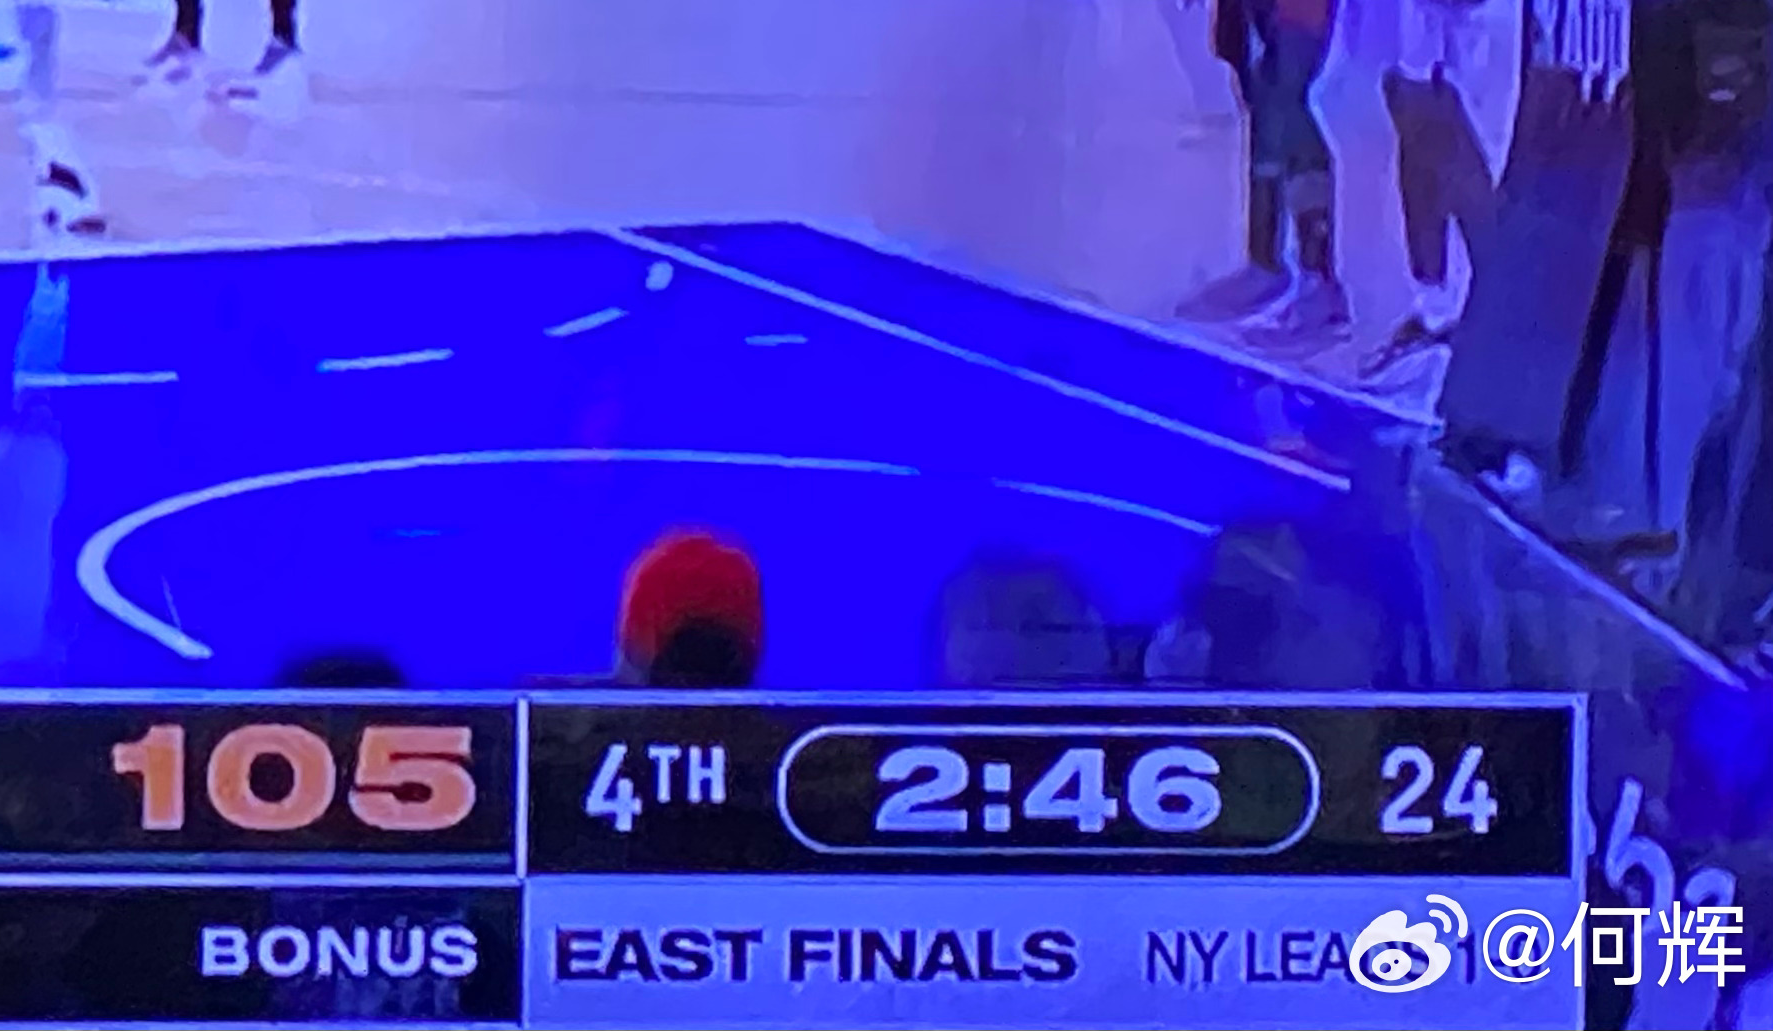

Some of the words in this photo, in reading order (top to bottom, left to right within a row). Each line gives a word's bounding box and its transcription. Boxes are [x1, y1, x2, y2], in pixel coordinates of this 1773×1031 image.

[111, 723, 477, 831] 105
[585, 744, 727, 832] 4TH
[875, 746, 1222, 833] 2:46
[1379, 745, 1498, 834] 24
[200, 925, 479, 978] BONUS
[555, 928, 763, 982] EAST
[788, 928, 1078, 982] FINALS
[1146, 929, 1229, 983] NY
